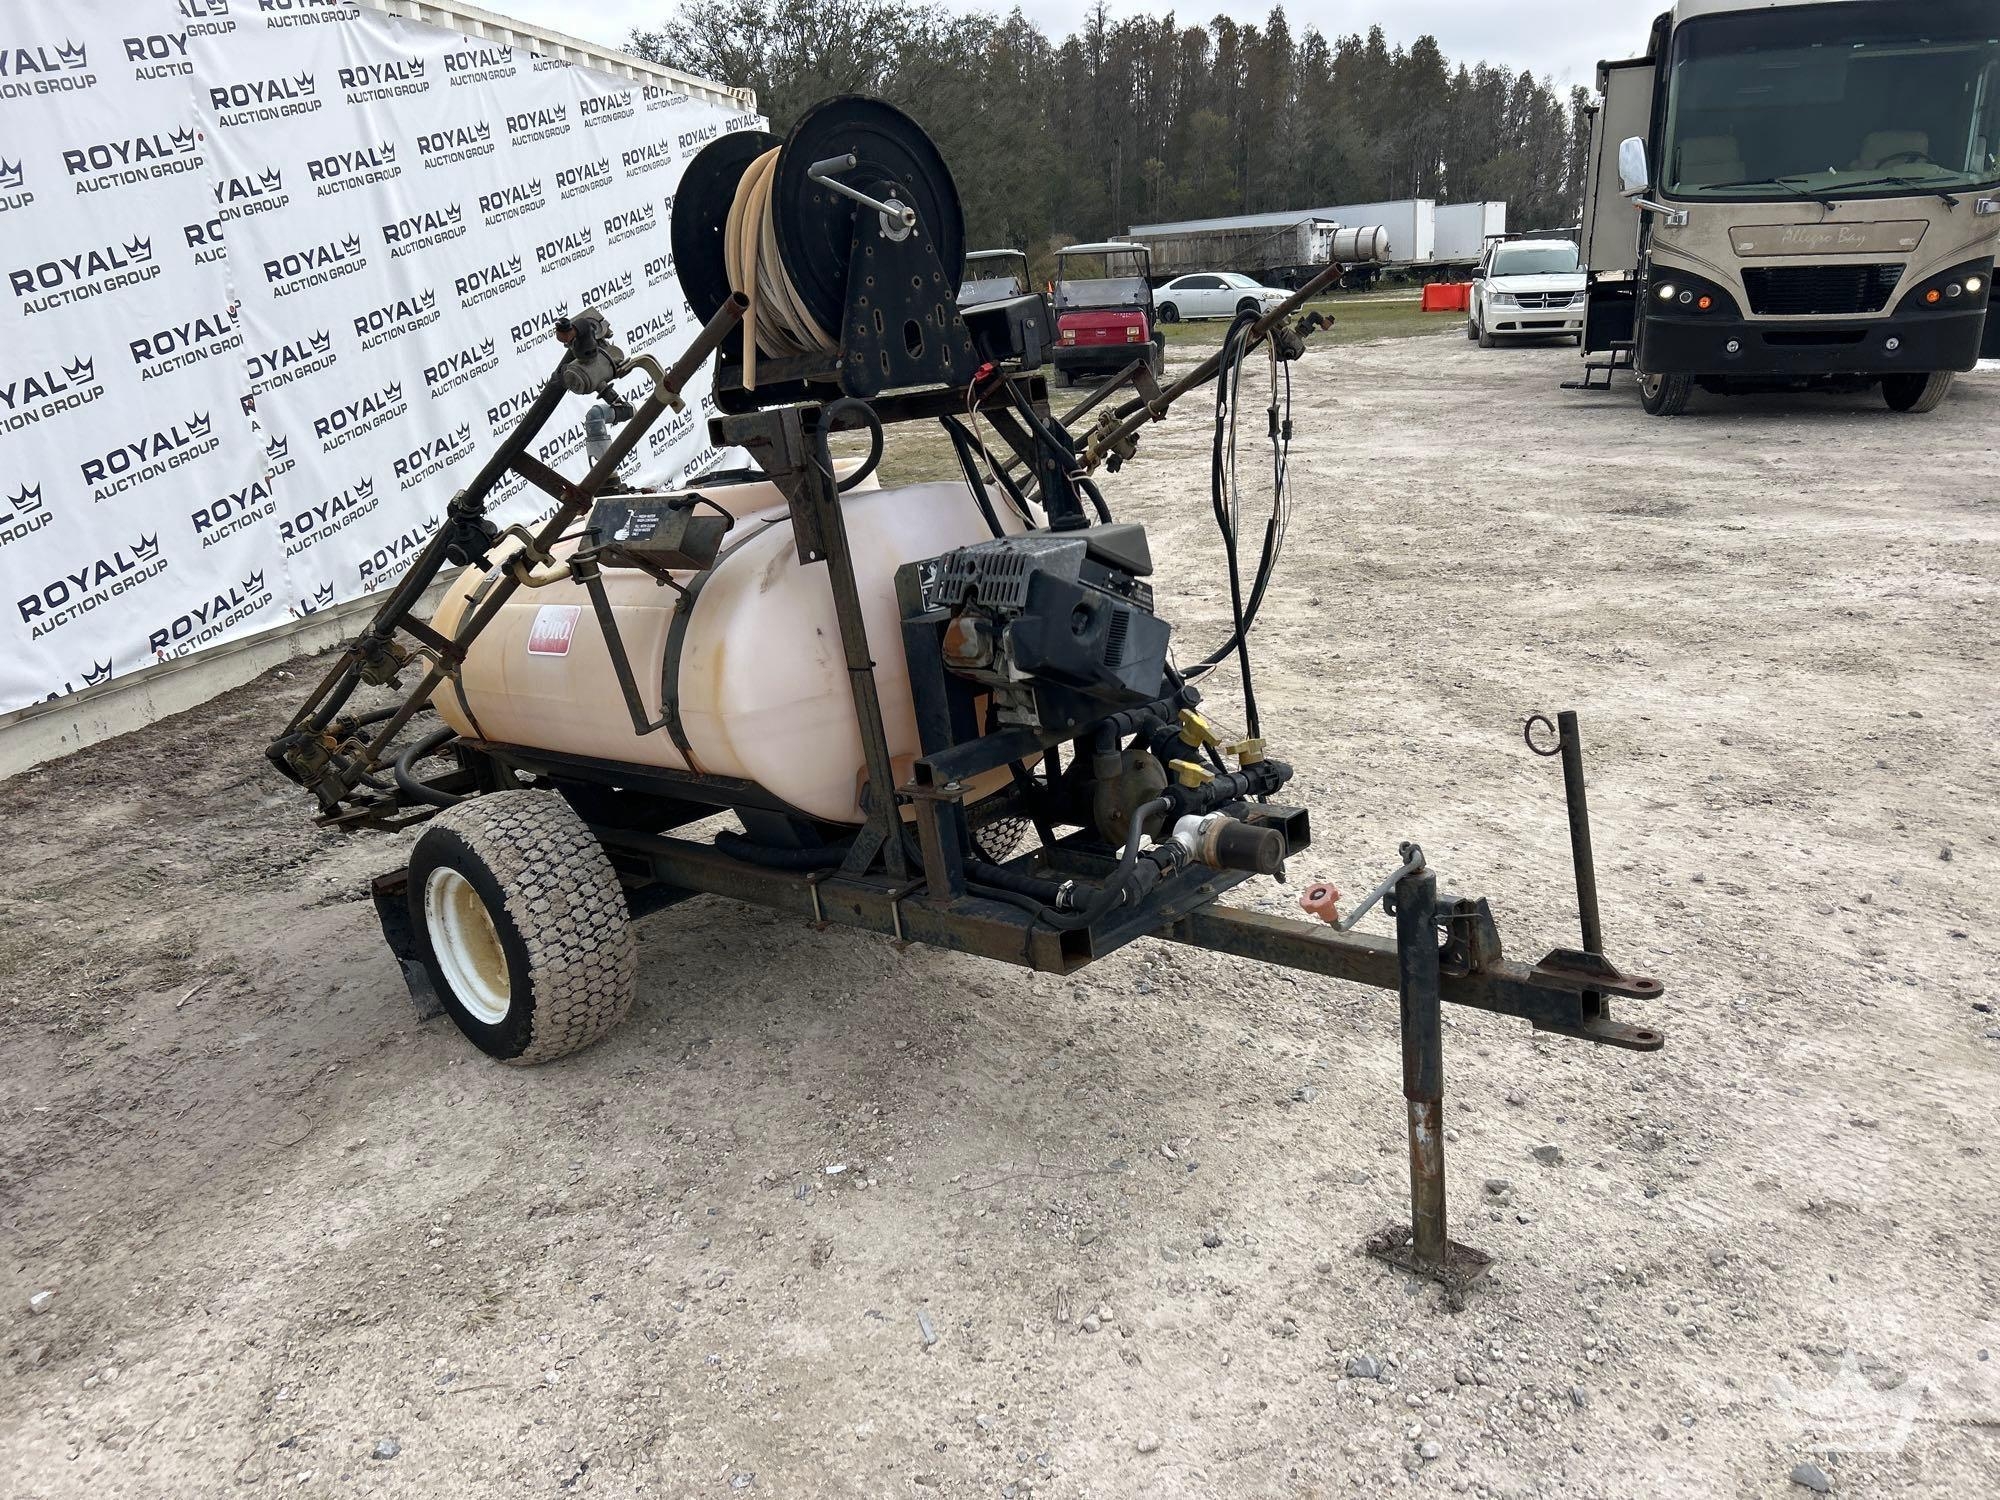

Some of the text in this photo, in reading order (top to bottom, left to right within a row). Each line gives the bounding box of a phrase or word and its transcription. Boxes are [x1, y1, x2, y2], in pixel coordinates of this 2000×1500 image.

[186, 21, 236, 37] GROUP
[267, 9, 360, 29] AUCTION GROUP
[122, 32, 187, 62] ROY
[444, 50, 500, 72] ROYAL
[34, 74, 97, 94] GROUP
[136, 62, 194, 81] AUCTIO
[338, 62, 409, 87] ROYAL
[450, 72, 488, 87] AUCTION
[209, 78, 299, 110] ROYAL
[347, 81, 429, 105] AUCTION GROUP
[580, 95, 622, 115] ROYAL
[642, 86, 676, 100] ROY
[220, 99, 322, 128] AUCTION GROUP
[506, 109, 555, 133] ROYAL
[417, 126, 477, 154] ROYAL
[512, 132, 544, 147] AUCTION
[678, 128, 710, 148] ROYAL
[62, 135, 174, 175] ROYAL
[307, 148, 382, 181] ROYAL
[425, 152, 464, 170] AUCTION
[622, 145, 660, 164] ROYAL
[76, 156, 204, 195] AUCTION GROUP
[213, 176, 263, 204] YAL
[317, 166, 401, 197] AUCTION GROUP
[556, 163, 600, 186] ROYAL
[0, 192, 34, 212] OUP
[243, 195, 289, 216] GROUP
[479, 186, 531, 213] ROYAL
[382, 211, 448, 245] ROYAL
[485, 209, 519, 227] AUCTION
[604, 210, 645, 234] ROYAL
[391, 226, 466, 257] AUCTION GROUP
[536, 234, 582, 262] ROYAL
[1782, 226, 1866, 249] Allegro Bay
[8, 246, 128, 297] ROYAL
[263, 242, 345, 283] ROYAL
[644, 253, 674, 277] ROYA
[24, 265, 161, 316] AUCTION GROUP
[274, 258, 367, 299] AUCTION GROUP
[455, 262, 511, 296] ROYAL
[581, 280, 623, 306] ROYAL
[461, 289, 498, 308] AUCTION
[594, 300, 614, 313] CTION
[353, 297, 424, 337] ROYAL
[362, 310, 440, 352] AUCTION GROUP
[511, 309, 557, 343] ROYAL
[627, 316, 665, 345] ROYAL
[129, 314, 231, 364] ROYAL
[516, 332, 548, 354] AUCTION
[142, 334, 244, 382] AUCTION GRO
[247, 341, 313, 380] OYAL
[423, 347, 483, 386] ROYAL
[0, 371, 68, 410] YAL
[251, 354, 337, 396] CTION GROUP
[431, 372, 469, 399] AUCTION
[42, 385, 104, 418] GROUP
[487, 383, 541, 425] ROYAL
[622, 385, 645, 402] YAL
[313, 392, 387, 439] ROYAL
[323, 403, 407, 454] AUCTION GROUP
[539, 425, 584, 462] ROYAL
[649, 417, 685, 449] ROYAL
[80, 426, 190, 486] ROYAL
[95, 437, 219, 502] AUCTION GROUP
[268, 459, 296, 479] OUP
[393, 433, 460, 479] ROYAL
[683, 446, 717, 477] ROYAL
[401, 460, 444, 491] AUCTION
[191, 480, 272, 534] ROYA
[279, 490, 358, 543] ROYAL
[0, 512, 53, 547] ROUP
[203, 508, 263, 549] AUCTION
[286, 498, 379, 559] AUCTION GROUP
[358, 529, 427, 581] ROYAL
[17, 552, 136, 624] ROYAL
[32, 558, 168, 640] AUCTION GROUP
[148, 587, 245, 654] ROYAL
[225, 592, 272, 628] GROUP
